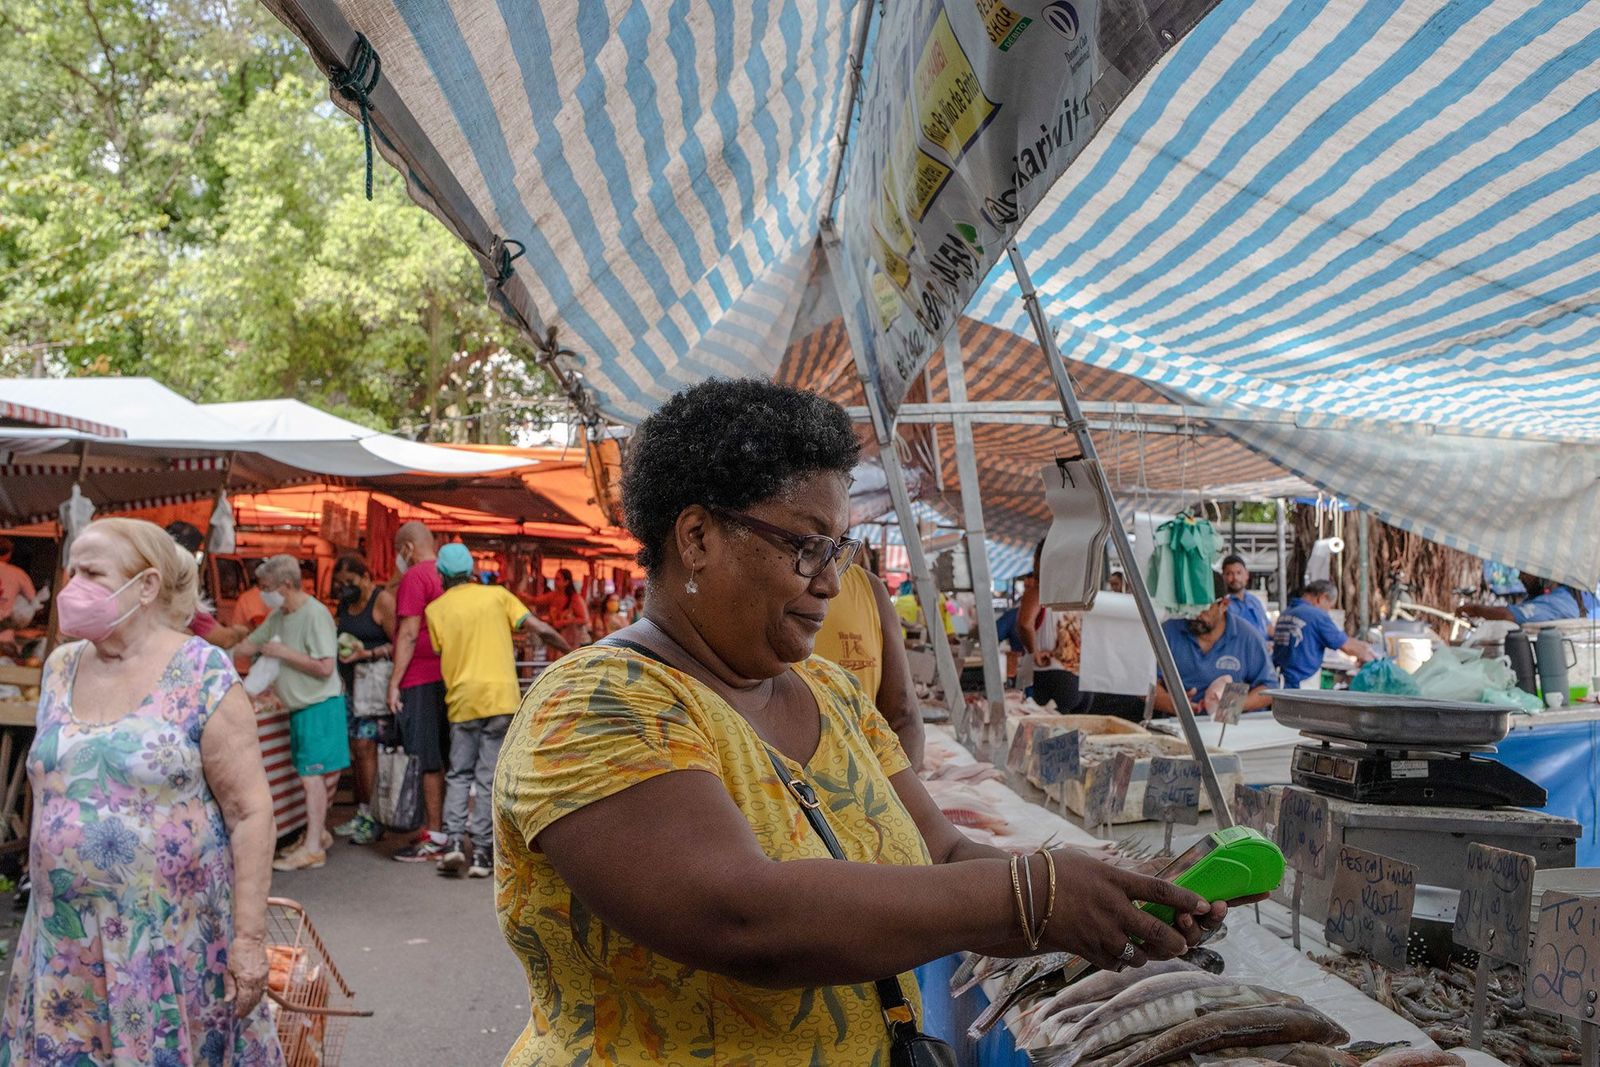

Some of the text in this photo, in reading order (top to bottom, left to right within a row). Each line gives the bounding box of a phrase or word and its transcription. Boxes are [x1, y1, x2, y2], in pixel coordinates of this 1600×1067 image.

[977, 0, 998, 19] RED
[986, 7, 1015, 42] SHOP
[949, 88, 967, 113] de
